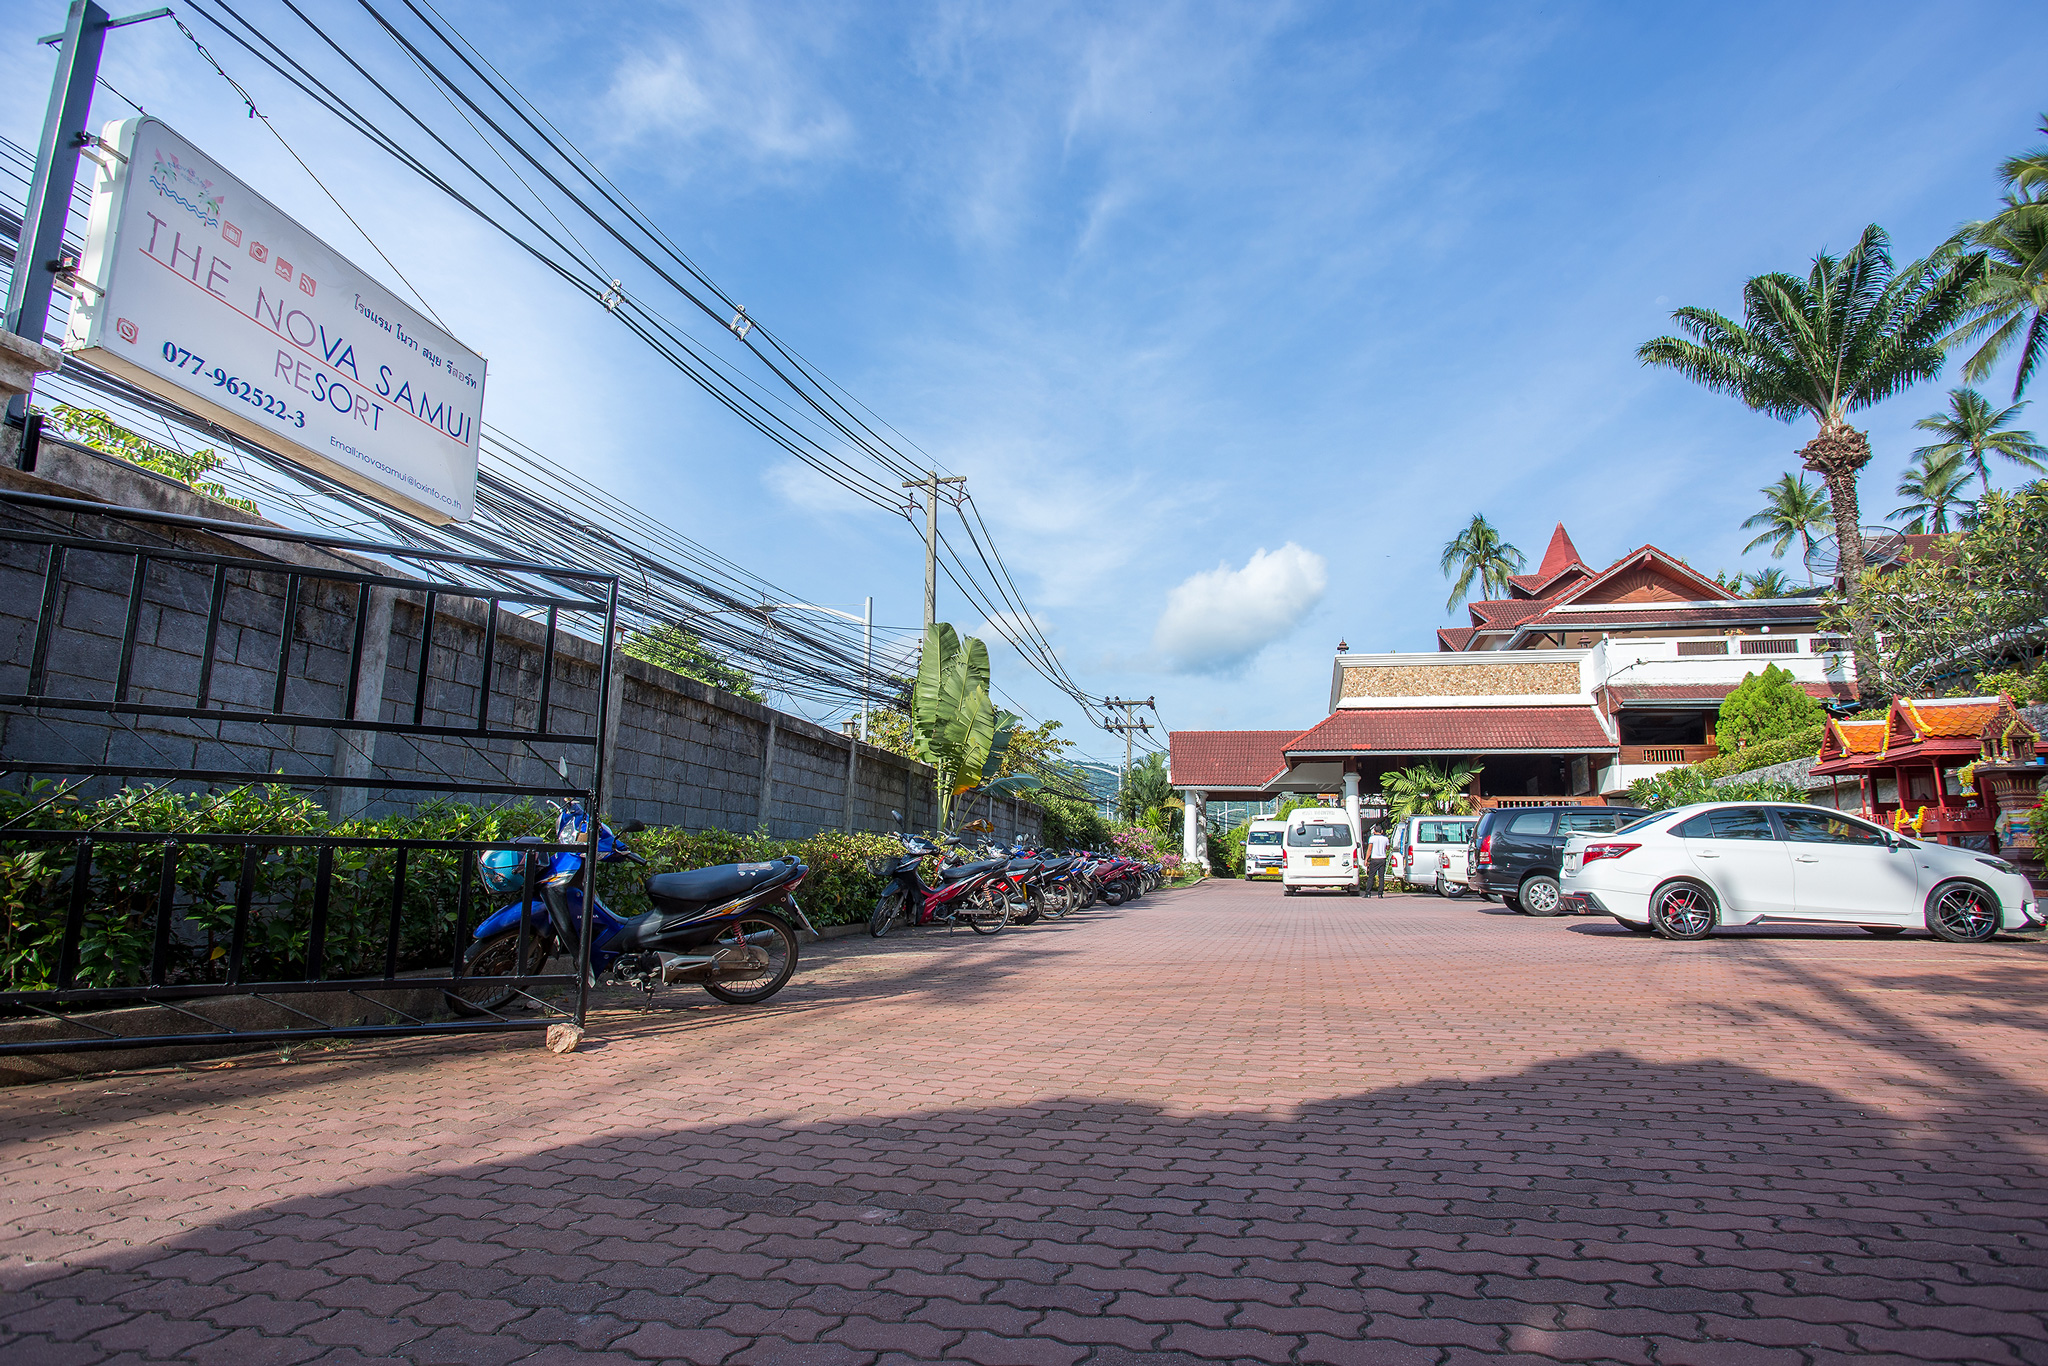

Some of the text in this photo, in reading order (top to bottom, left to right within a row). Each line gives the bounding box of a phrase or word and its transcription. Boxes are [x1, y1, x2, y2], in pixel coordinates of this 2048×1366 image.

[147, 211, 471, 444] THE NOVA SAMUI
[354, 293, 392, 333] โรงแรม
[396, 323, 419, 351] โนวา
[422, 347, 442, 368] สมุย
[162, 341, 306, 429] 077-962522-3
[274, 349, 384, 431] RESORT
[329, 435, 462, 510] Email:novasamui@loxinfo.co.th
